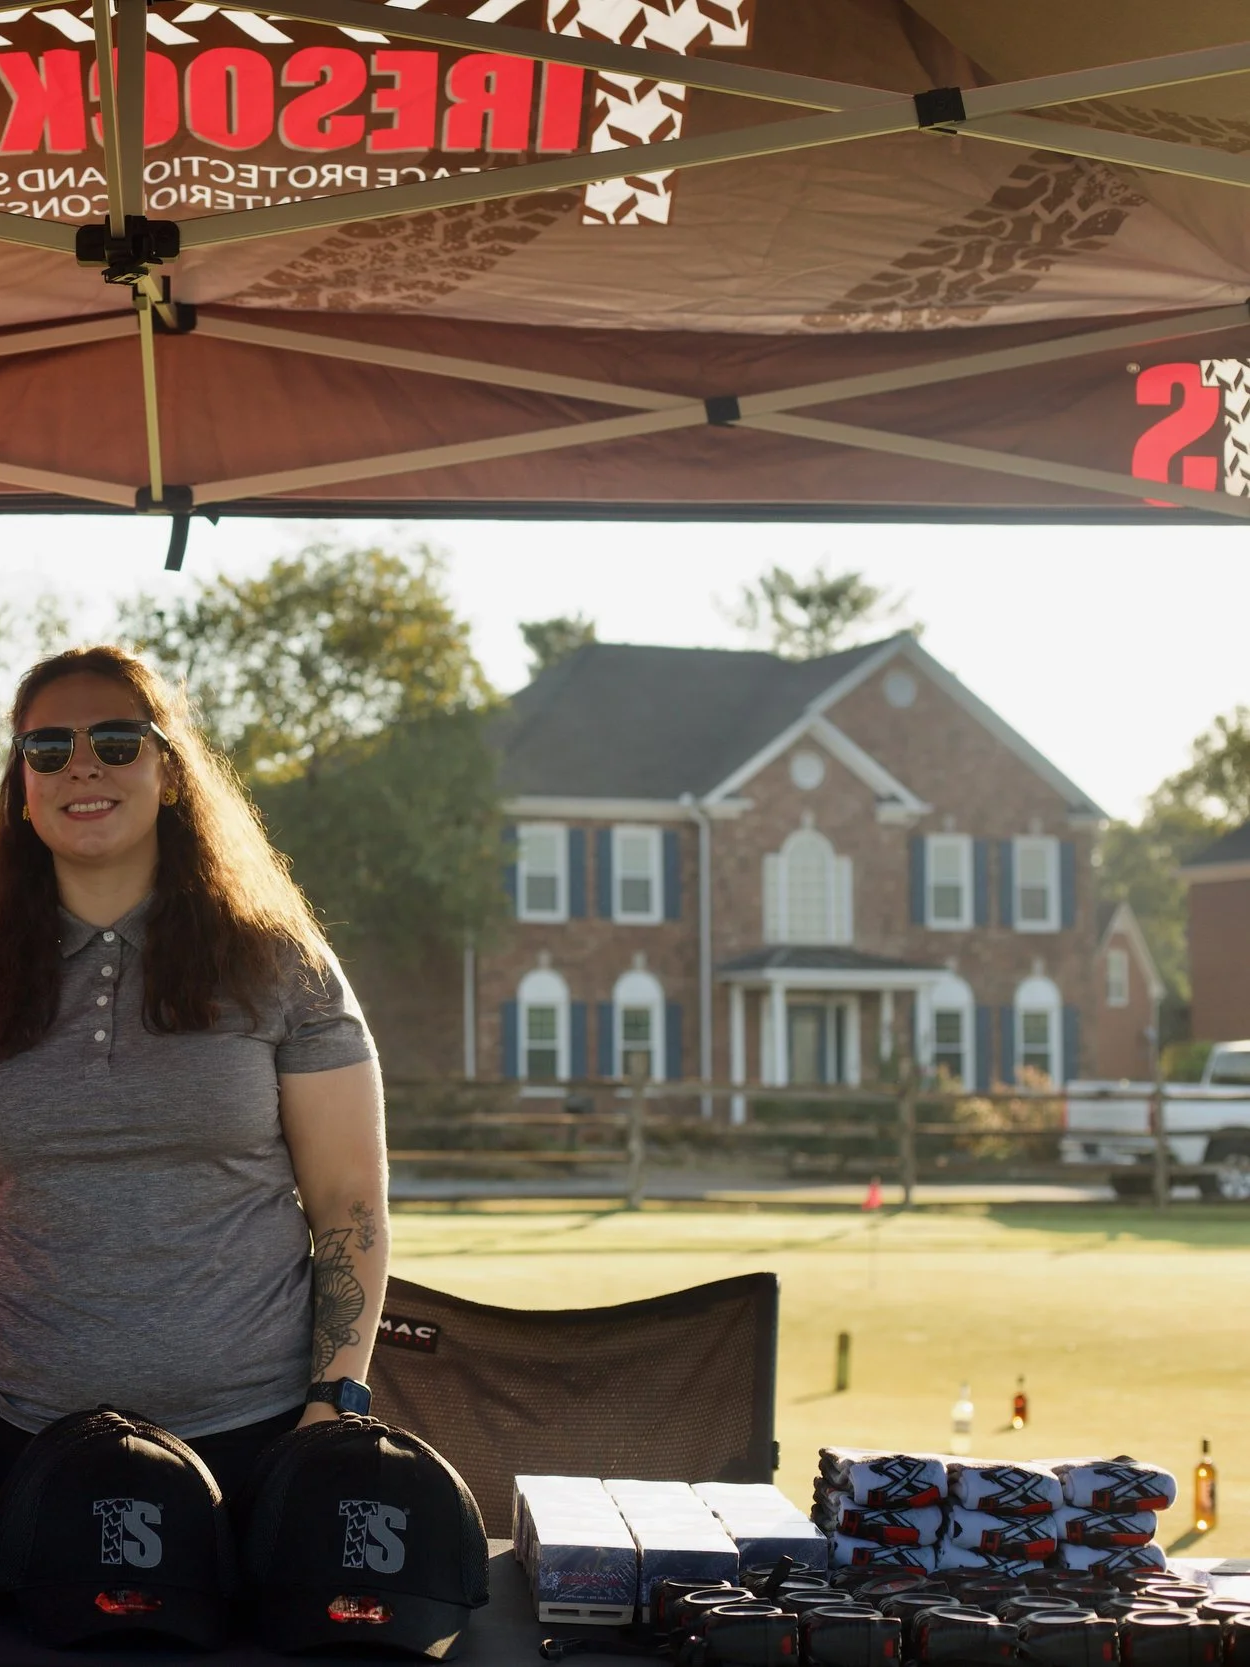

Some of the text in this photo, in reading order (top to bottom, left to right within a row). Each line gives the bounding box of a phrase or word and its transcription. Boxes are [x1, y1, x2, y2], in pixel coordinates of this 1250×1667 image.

[378, 1318, 433, 1339] MAC
[92, 1497, 163, 1568] TS
[338, 1499, 407, 1574] TS
